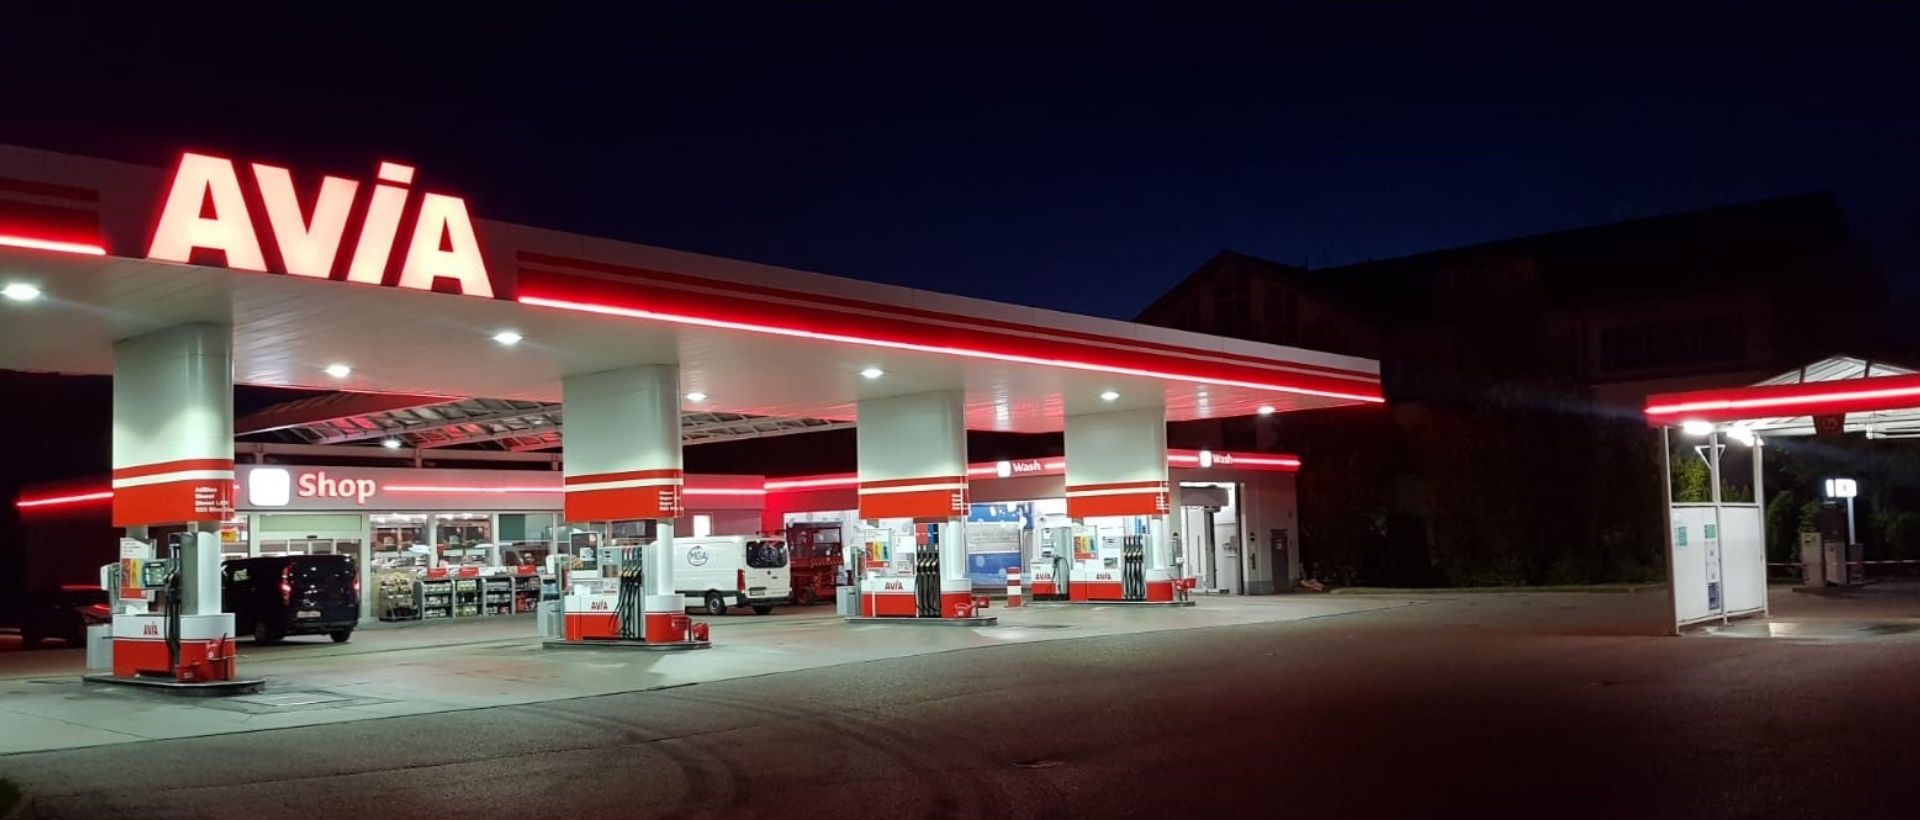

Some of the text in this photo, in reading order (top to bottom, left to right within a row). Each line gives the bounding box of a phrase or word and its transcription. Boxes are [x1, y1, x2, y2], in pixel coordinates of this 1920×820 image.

[1213, 453, 1233, 464] Wash
[1012, 460, 1041, 472] Wash
[298, 471, 376, 504] Shop
